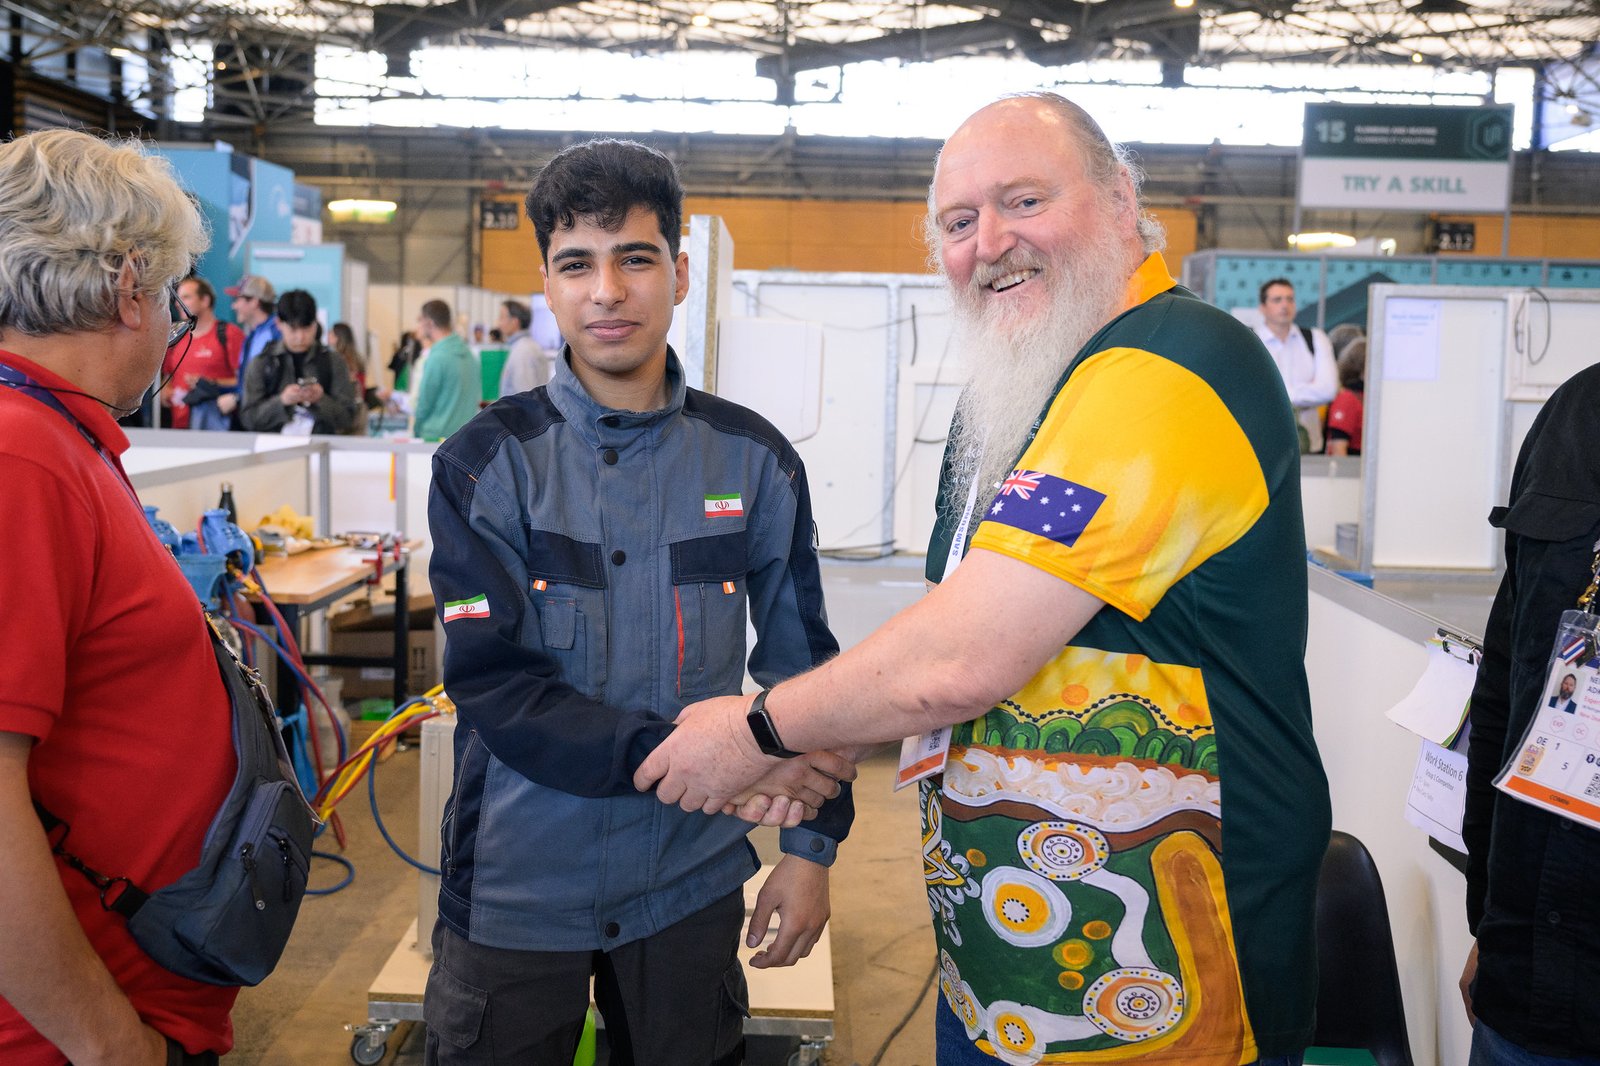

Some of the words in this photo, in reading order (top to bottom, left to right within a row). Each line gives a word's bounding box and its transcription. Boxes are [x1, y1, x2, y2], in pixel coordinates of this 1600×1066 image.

[1315, 120, 1346, 143] 15
[1343, 175, 1381, 192] TRY
[1387, 176, 1403, 193] A
[1410, 176, 1467, 194] SKILL
[952, 505, 972, 557] SAMSUNG
[1425, 750, 1438, 767] Work
[1437, 758, 1458, 779] Station
[1457, 770, 1464, 782] 6
[1561, 762, 1569, 770] 5
